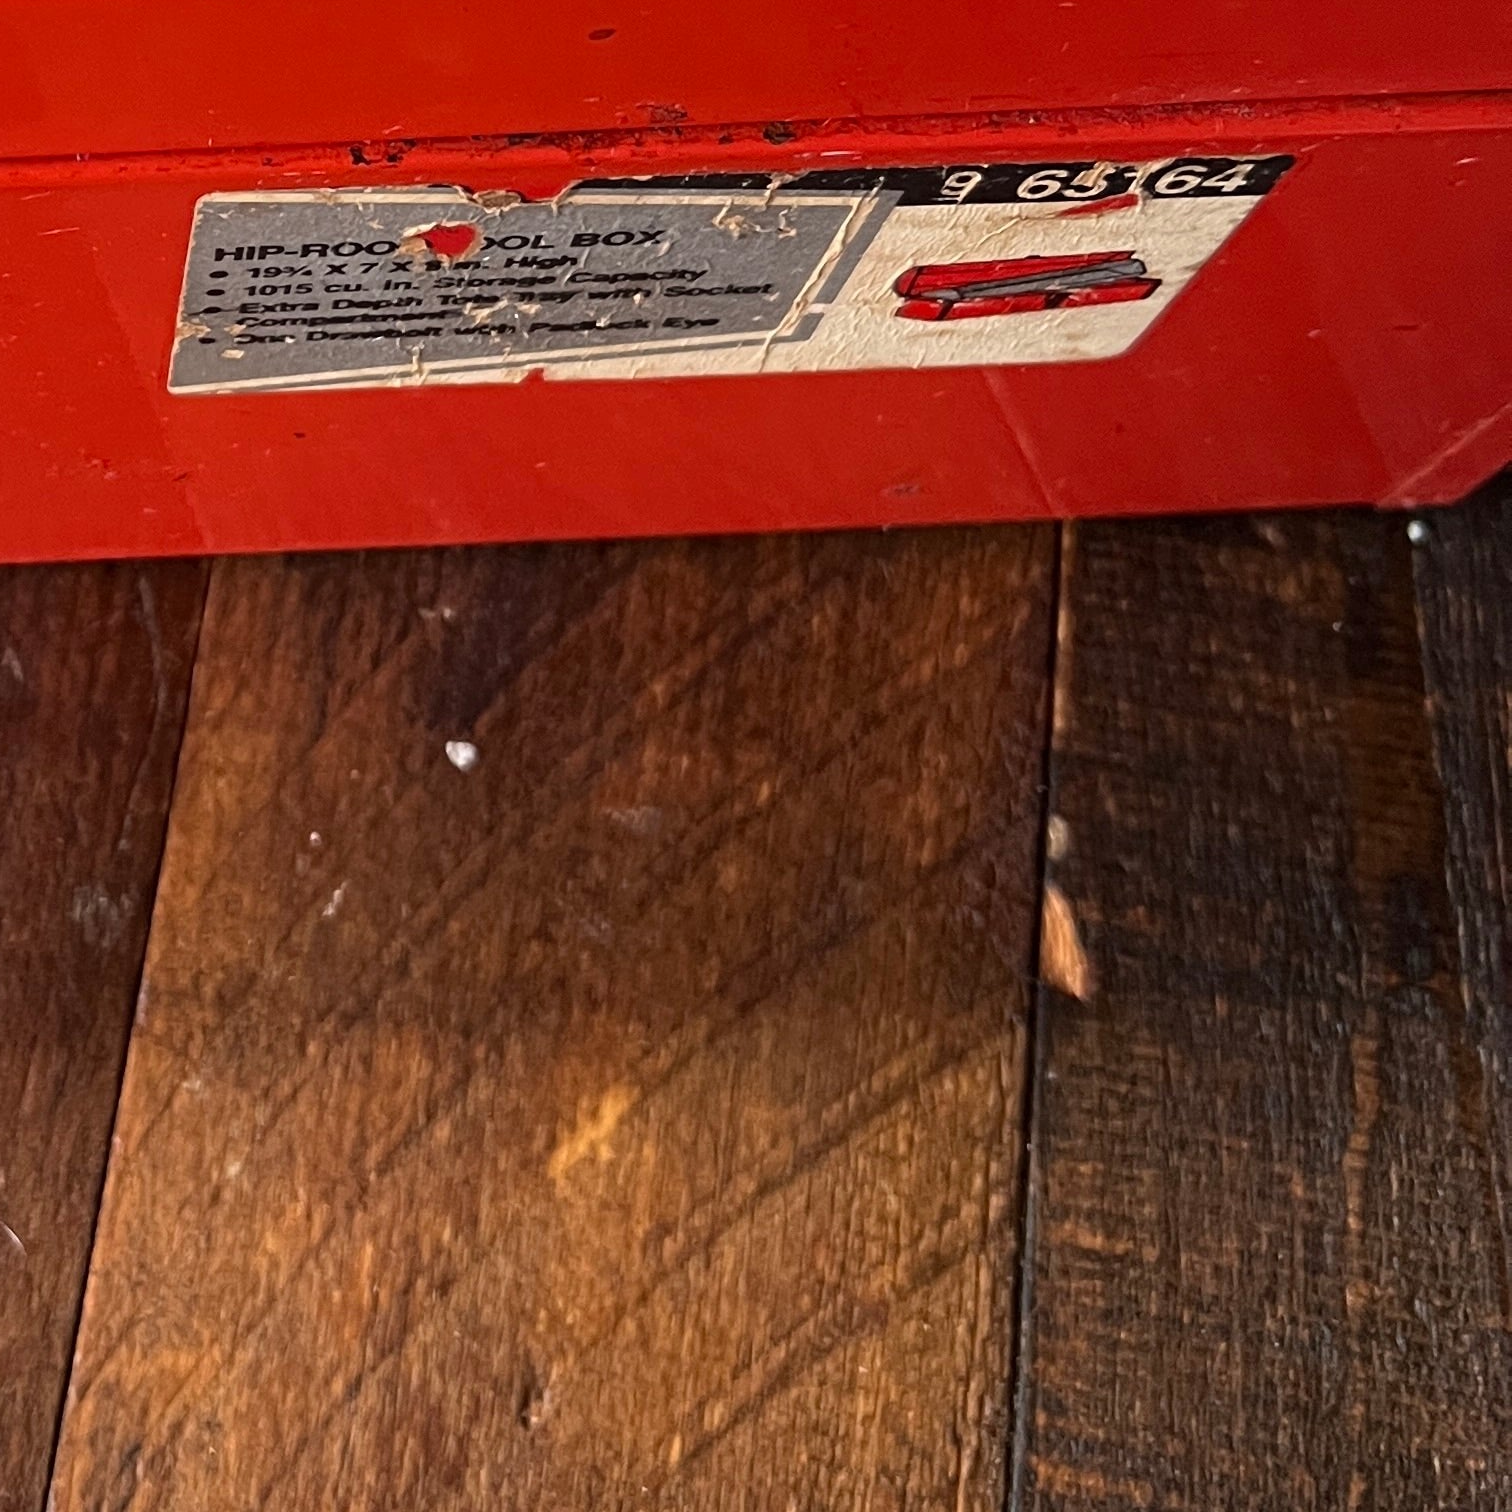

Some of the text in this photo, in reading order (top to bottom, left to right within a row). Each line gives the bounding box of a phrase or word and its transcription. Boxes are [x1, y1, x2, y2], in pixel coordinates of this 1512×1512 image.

[941, 170, 983, 198] 9
[214, 240, 400, 261] HIP-ROO
[569, 230, 666, 248] BOX
[360, 262, 379, 274] 7
[503, 255, 578, 269] High
[244, 283, 313, 296] 1015
[324, 282, 369, 293] cu.
[433, 275, 557, 288] Storage
[569, 269, 708, 284] Capacity
[238, 283, 775, 314] Extra Depth Tote Tray with Socket
[236, 310, 449, 327] Compartment
[305, 326, 443, 342] Drawbolt
[662, 317, 720, 330] Eye
